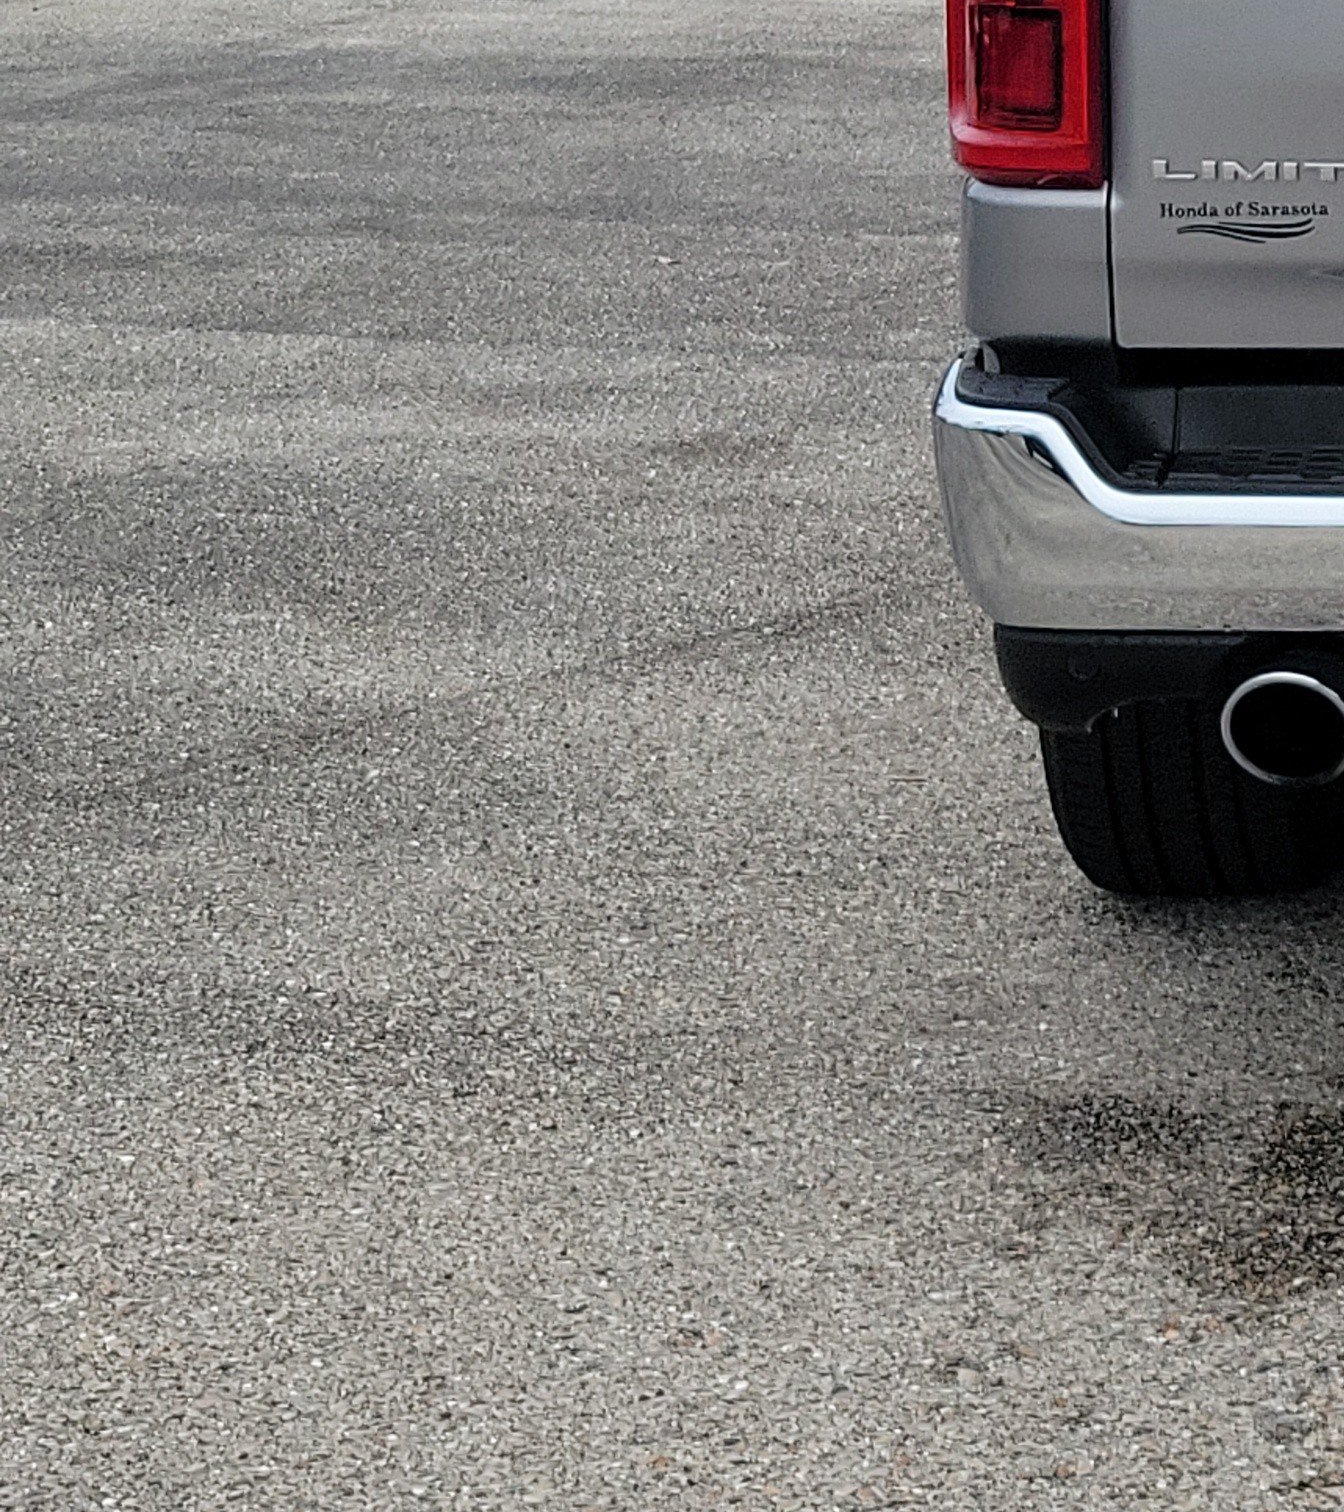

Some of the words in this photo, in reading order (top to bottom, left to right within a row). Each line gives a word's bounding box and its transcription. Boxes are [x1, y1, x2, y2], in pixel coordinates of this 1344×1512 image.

[1159, 202, 1219, 218] Honda
[1225, 201, 1245, 217] of
[1248, 201, 1330, 217] Sarasota
